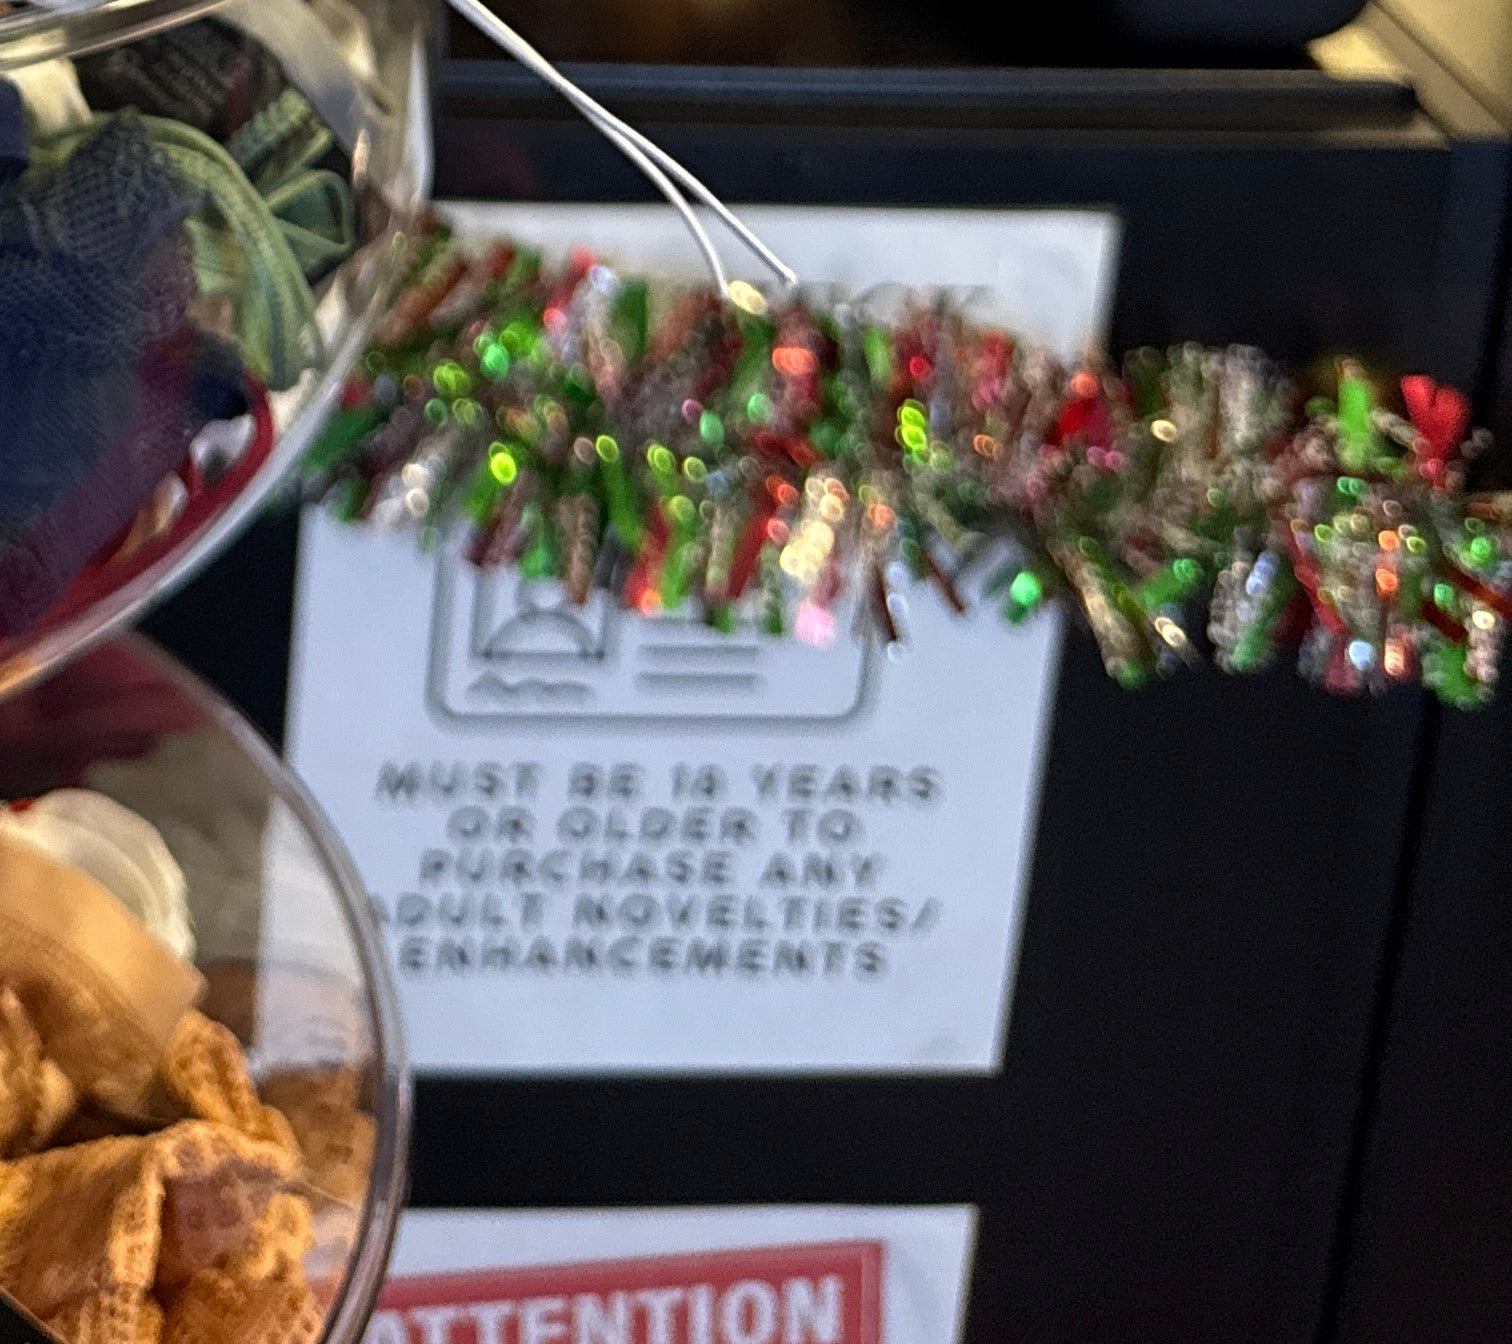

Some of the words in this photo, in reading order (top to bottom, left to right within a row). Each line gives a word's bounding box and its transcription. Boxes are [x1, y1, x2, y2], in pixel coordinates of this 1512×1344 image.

[376, 762, 540, 801] MUST
[568, 763, 643, 801] BE
[753, 764, 941, 802] YEARS
[447, 806, 534, 842] OR
[558, 806, 758, 843] OLDER
[785, 807, 863, 842] TO
[419, 848, 734, 887] PURCHASE
[760, 850, 886, 887] ANY
[398, 936, 887, 979] ENHANCEMENTS
